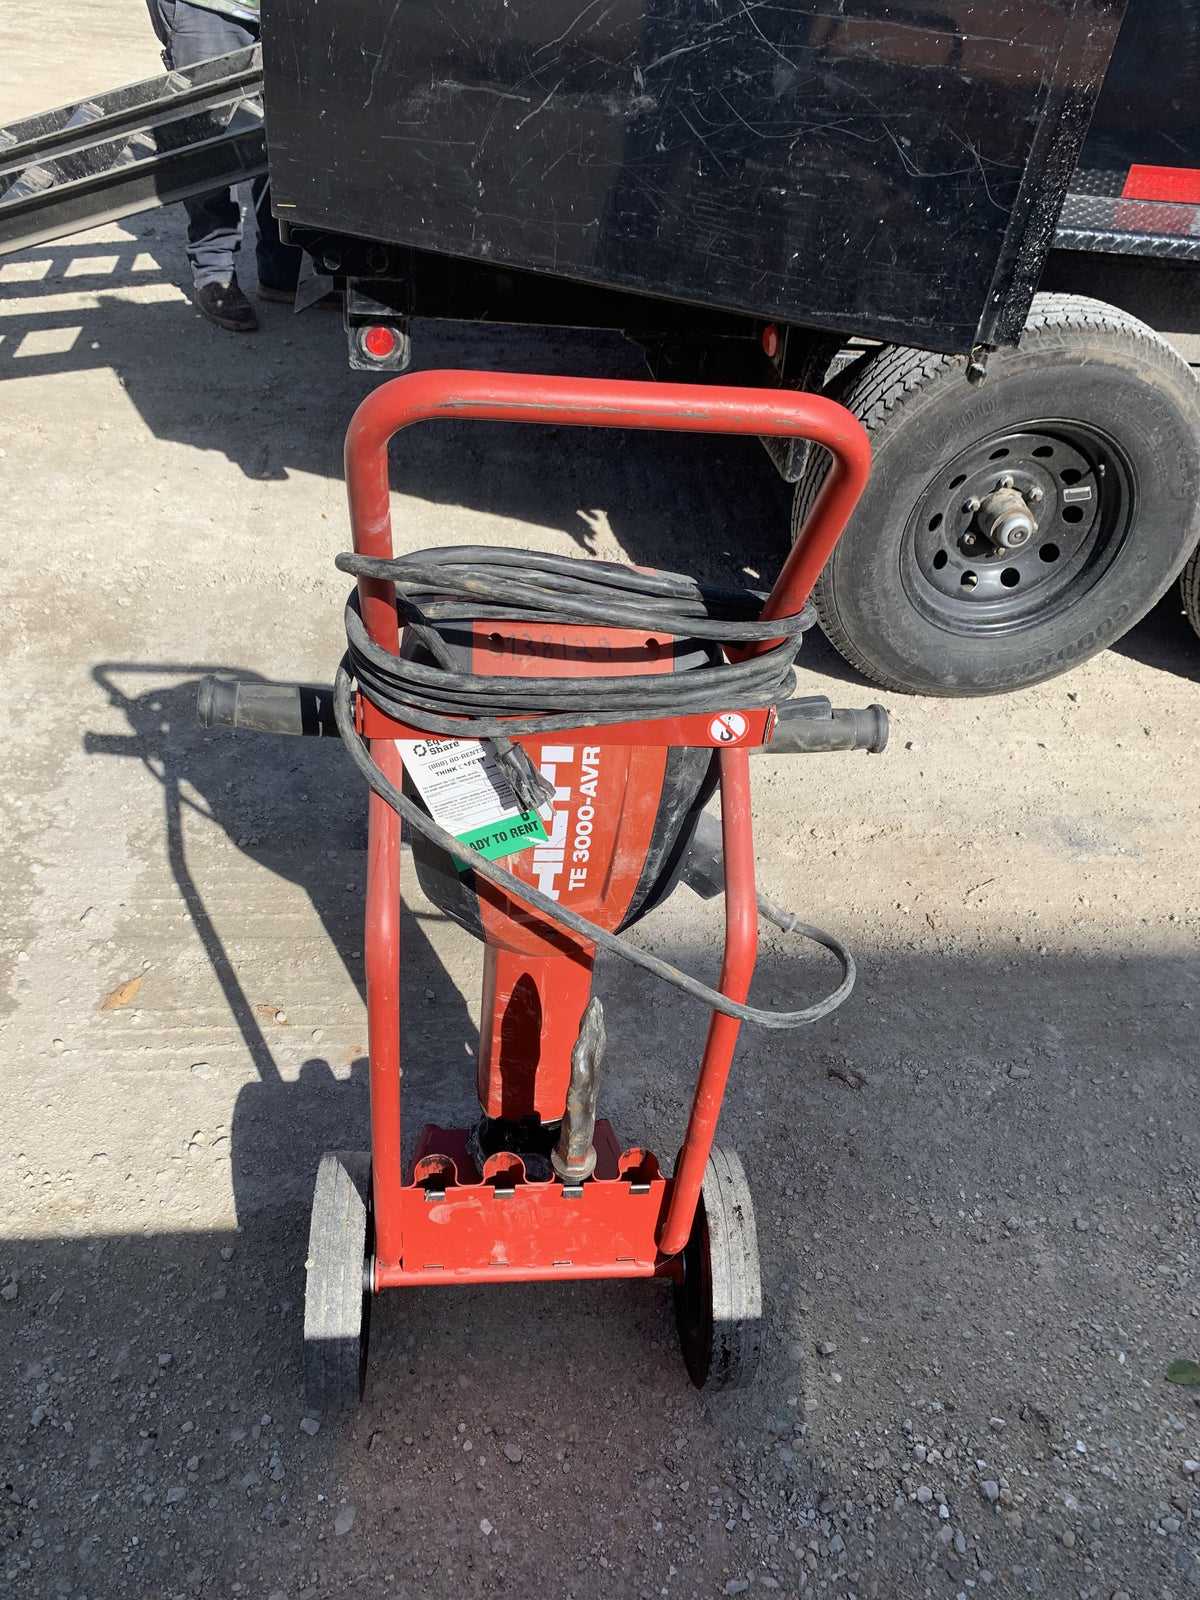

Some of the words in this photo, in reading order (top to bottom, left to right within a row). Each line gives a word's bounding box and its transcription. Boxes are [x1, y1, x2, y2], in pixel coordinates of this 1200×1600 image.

[429, 741, 460, 755] Share
[435, 766, 458, 777] THINK
[572, 746, 601, 863] 3000-AVR
[469, 836, 491, 851] ADY
[492, 831, 508, 844] TO
[509, 820, 539, 839] RENT
[568, 868, 588, 891] TE
